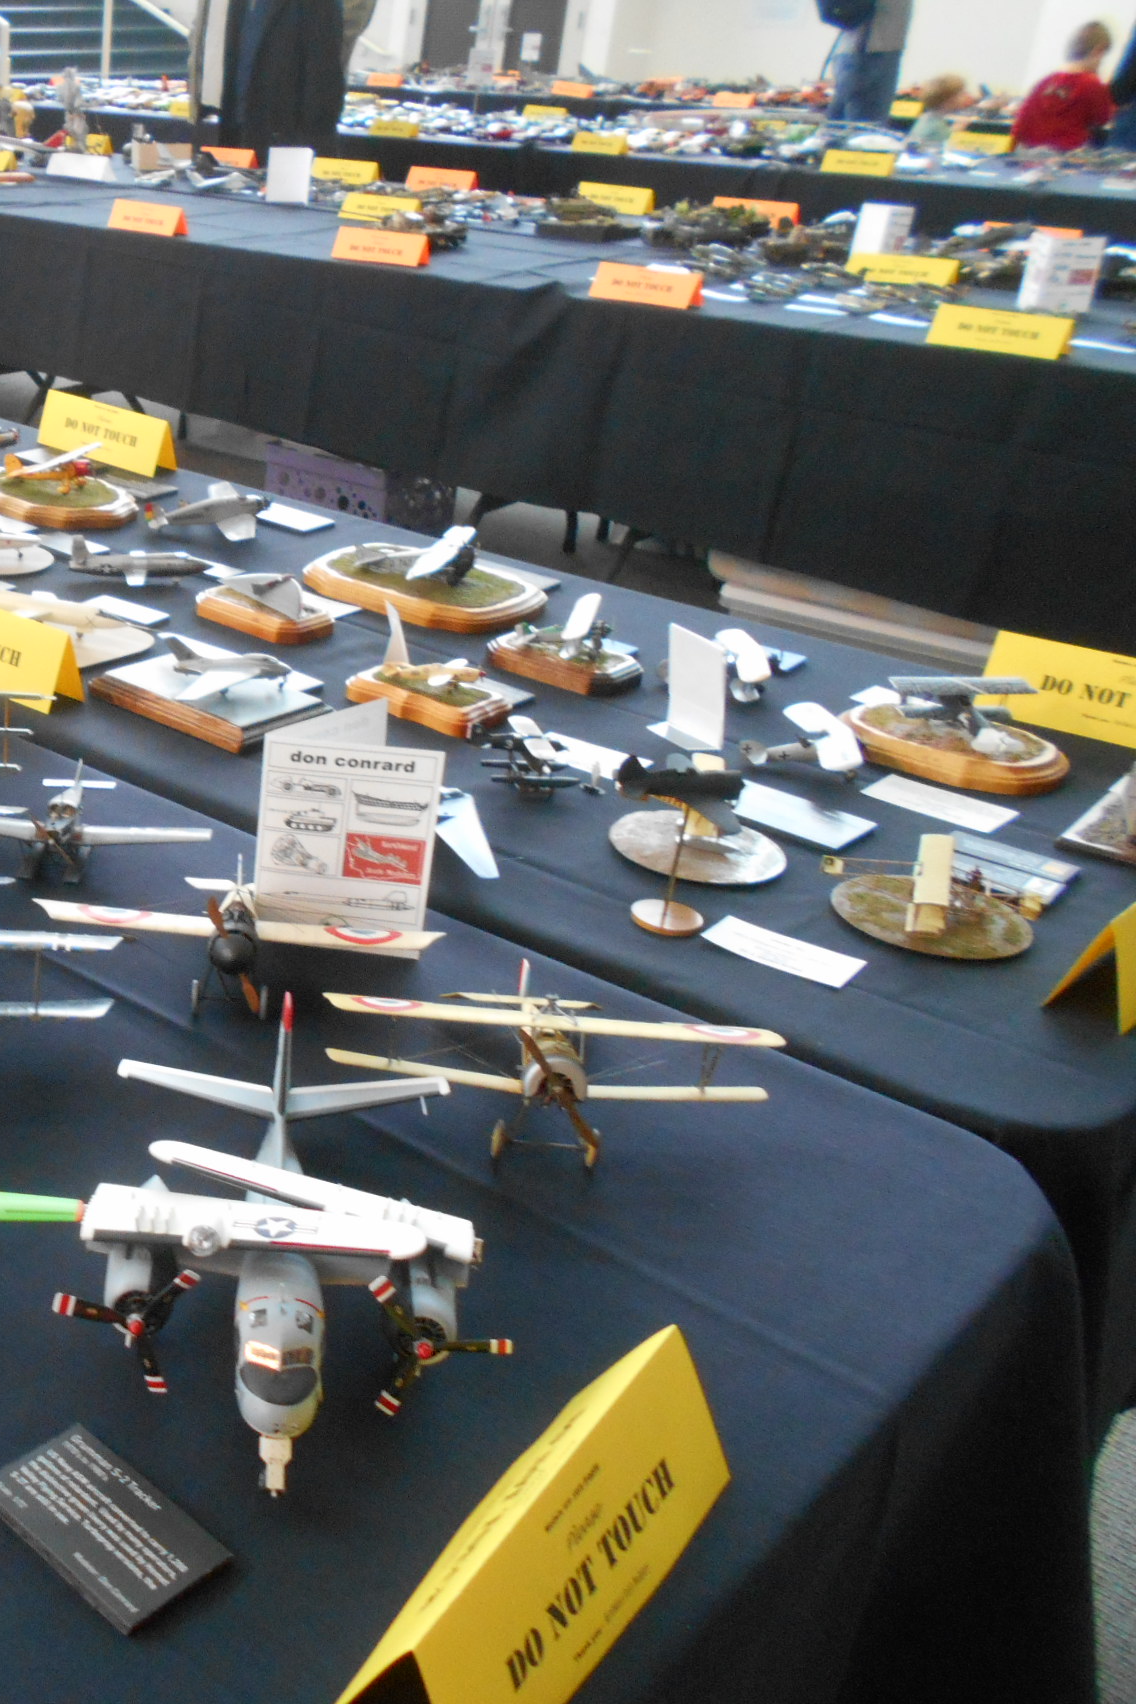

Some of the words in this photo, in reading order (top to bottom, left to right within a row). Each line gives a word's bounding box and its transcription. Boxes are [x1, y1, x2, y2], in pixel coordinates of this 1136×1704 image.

[958, 322, 973, 331] DO
[978, 324, 998, 335] NOT
[1001, 327, 1040, 339] TOUCH
[64, 417, 78, 429] DO
[82, 422, 101, 437] NOT
[103, 428, 138, 447] TOUCH
[1041, 674, 1073, 695] DO
[1079, 683, 1132, 708] NOT
[290, 751, 327, 766] don
[335, 755, 416, 773] conrard
[125, 1481, 163, 1512] Tracker
[507, 1628, 545, 1693] DO
[545, 1554, 597, 1641] NOT
[596, 1457, 675, 1569] TOUCH
